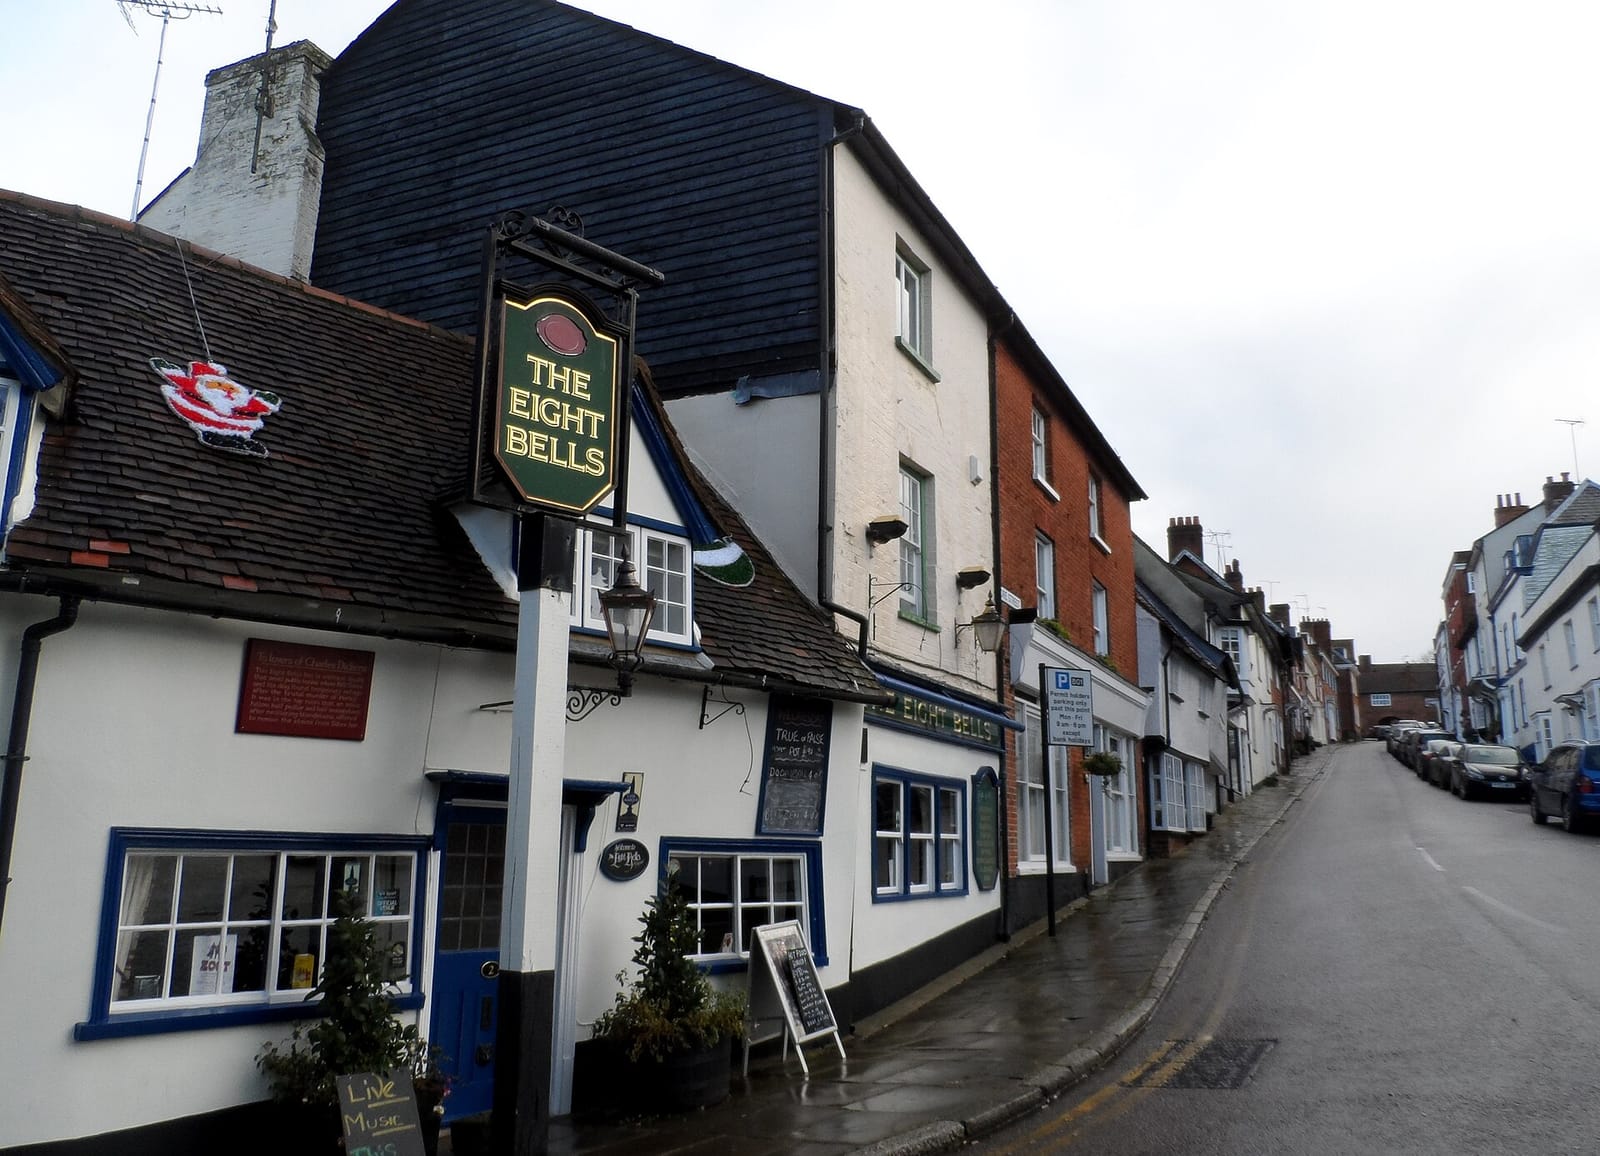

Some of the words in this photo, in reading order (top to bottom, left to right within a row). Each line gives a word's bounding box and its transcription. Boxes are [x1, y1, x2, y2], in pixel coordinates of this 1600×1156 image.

[526, 353, 591, 401] THE
[508, 386, 605, 439] EIGHT
[504, 424, 605, 477] BELLS
[1058, 674, 1068, 688] P
[775, 727, 800, 743] TRUE
[903, 696, 947, 729] EIGHT
[953, 710, 992, 741] BELLS
